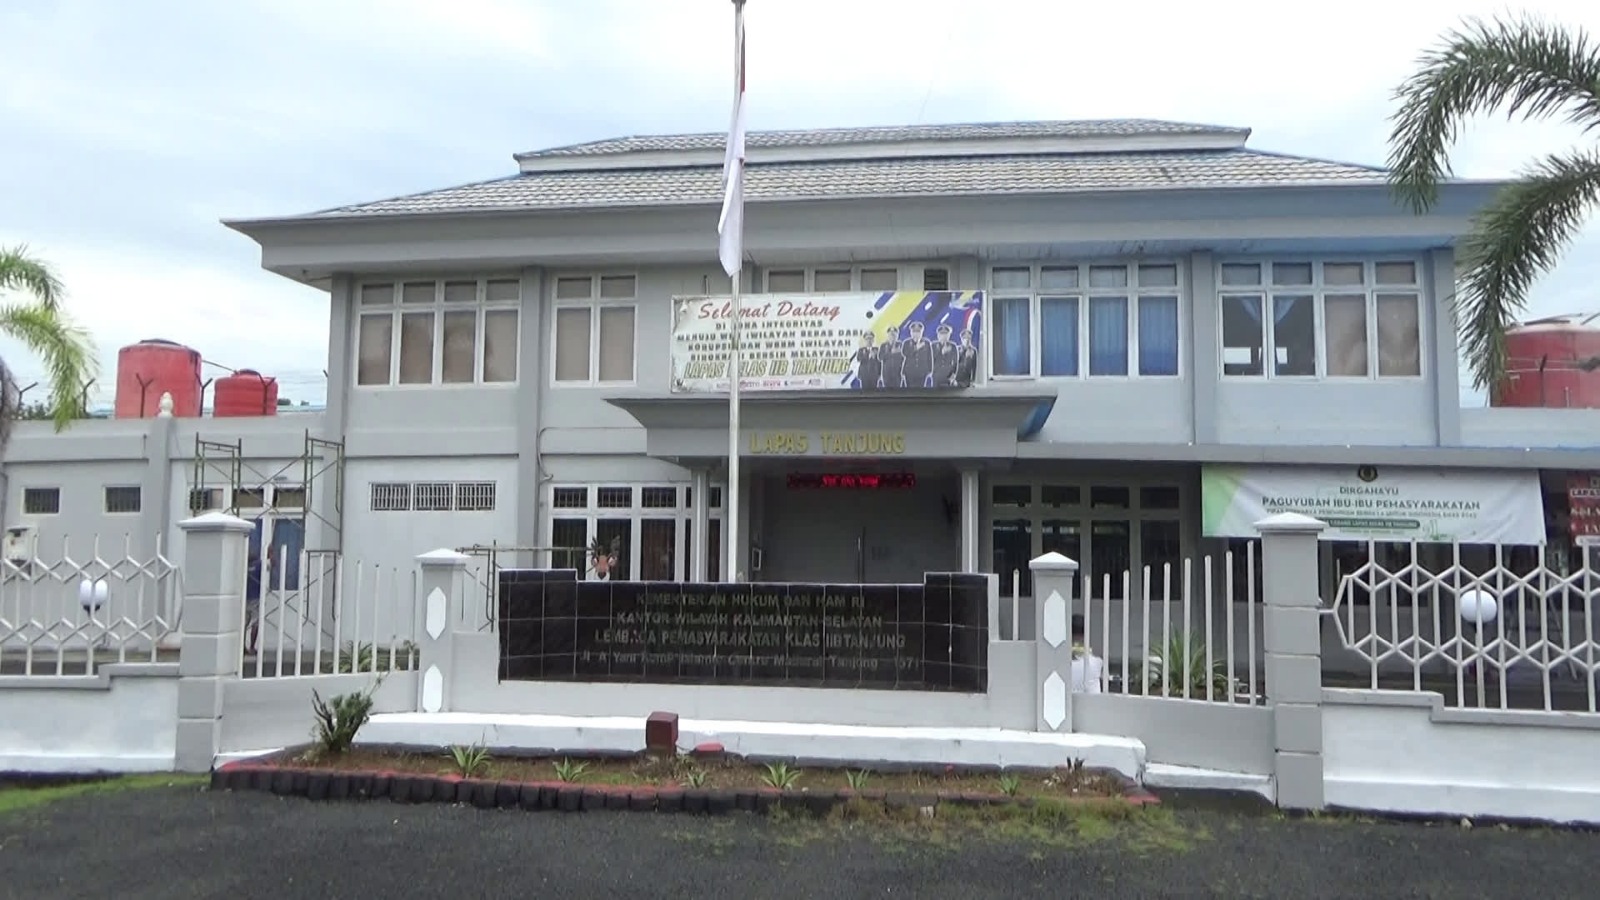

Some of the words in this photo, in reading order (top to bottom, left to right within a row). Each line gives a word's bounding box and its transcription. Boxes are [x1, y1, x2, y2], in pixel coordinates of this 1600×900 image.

[777, 300, 840, 320] Datang
[762, 319, 823, 329] INTEGRITAS
[838, 329, 863, 337] DARI
[684, 361, 725, 379] LAPAS
[792, 358, 850, 375] TANJUNG
[751, 431, 808, 454] LAPAS
[821, 431, 904, 454] TANJUNG
[1339, 486, 1399, 495] DIRGAHAYU
[1262, 497, 1330, 507] PAGUYUBAN
[1376, 500, 1480, 510] PEMASYARAKATAN
[731, 594, 778, 607] HUKUM
[616, 612, 670, 624] KANTOR
[675, 613, 728, 625] WILAYAH
[732, 614, 820, 626] KALIMANTAN
[824, 616, 883, 627] SELATAN
[661, 630, 780, 646] PEMASYARAKATAN
[785, 632, 820, 647] KLAS
